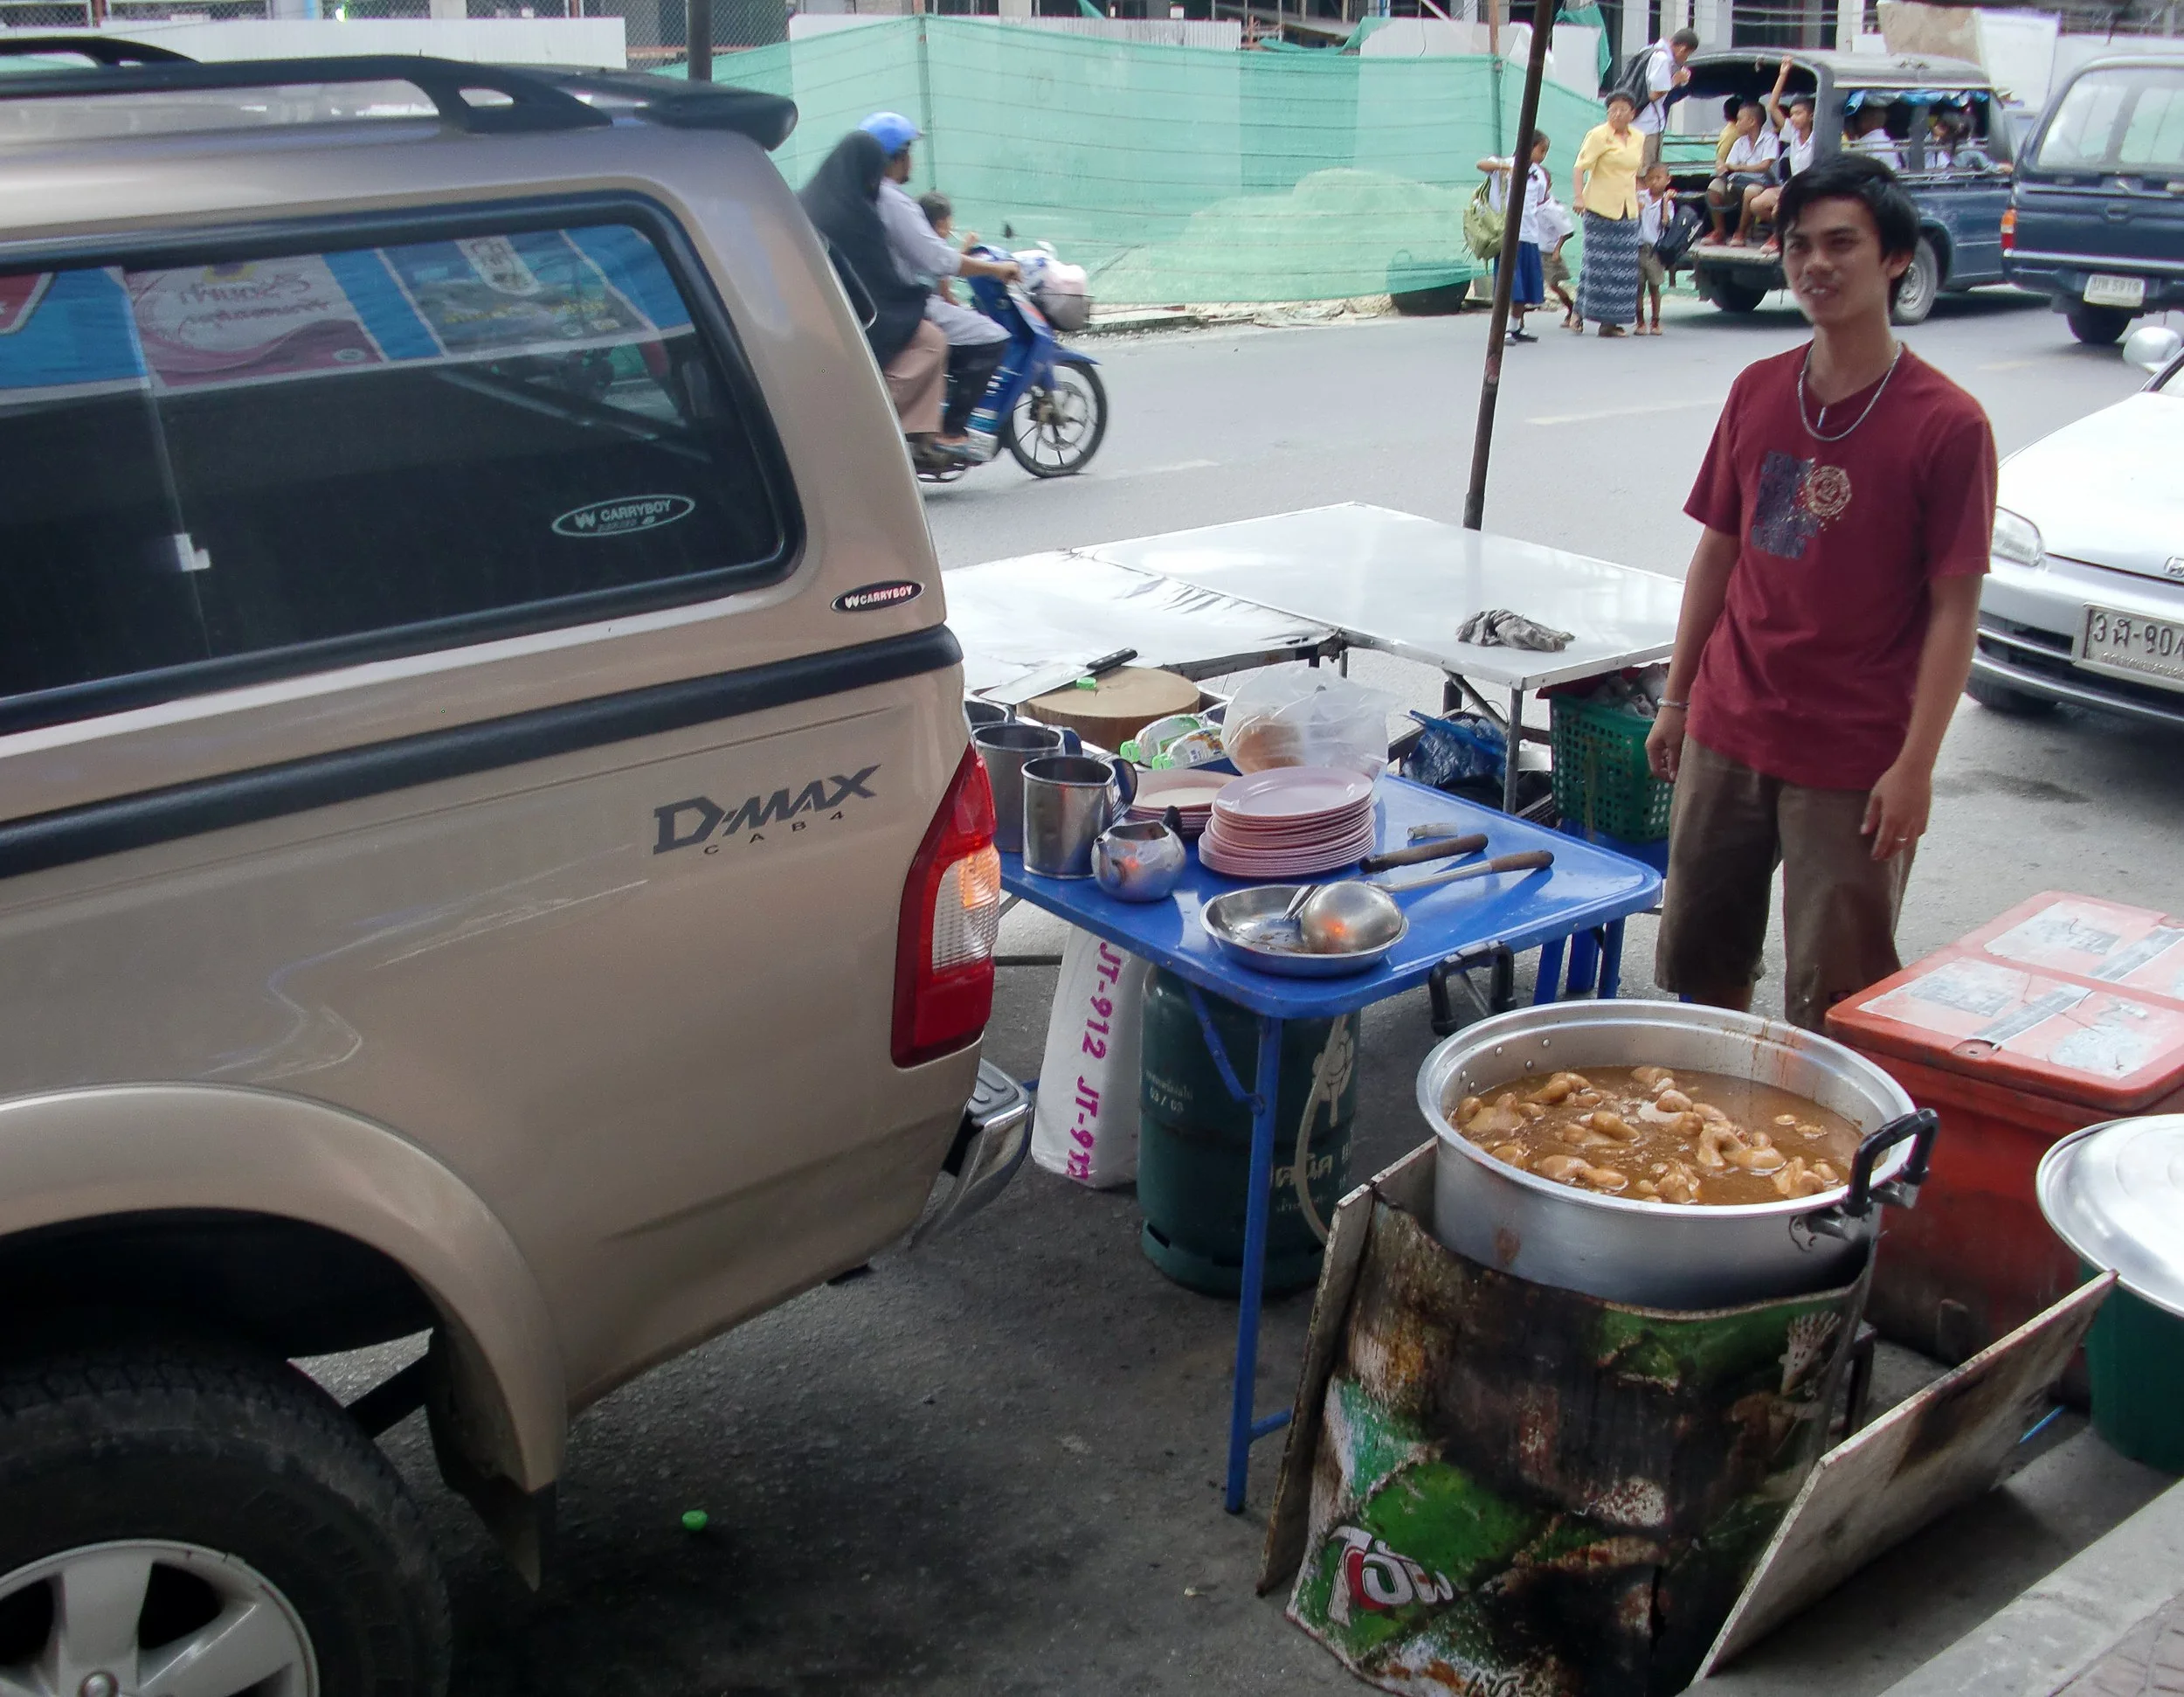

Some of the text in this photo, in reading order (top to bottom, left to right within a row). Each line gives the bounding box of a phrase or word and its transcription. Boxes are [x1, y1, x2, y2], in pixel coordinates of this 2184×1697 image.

[600, 500, 671, 522] CARRYBOY
[860, 585, 913, 605] CARRYBOY
[1082, 942, 1122, 1059] JT-912
